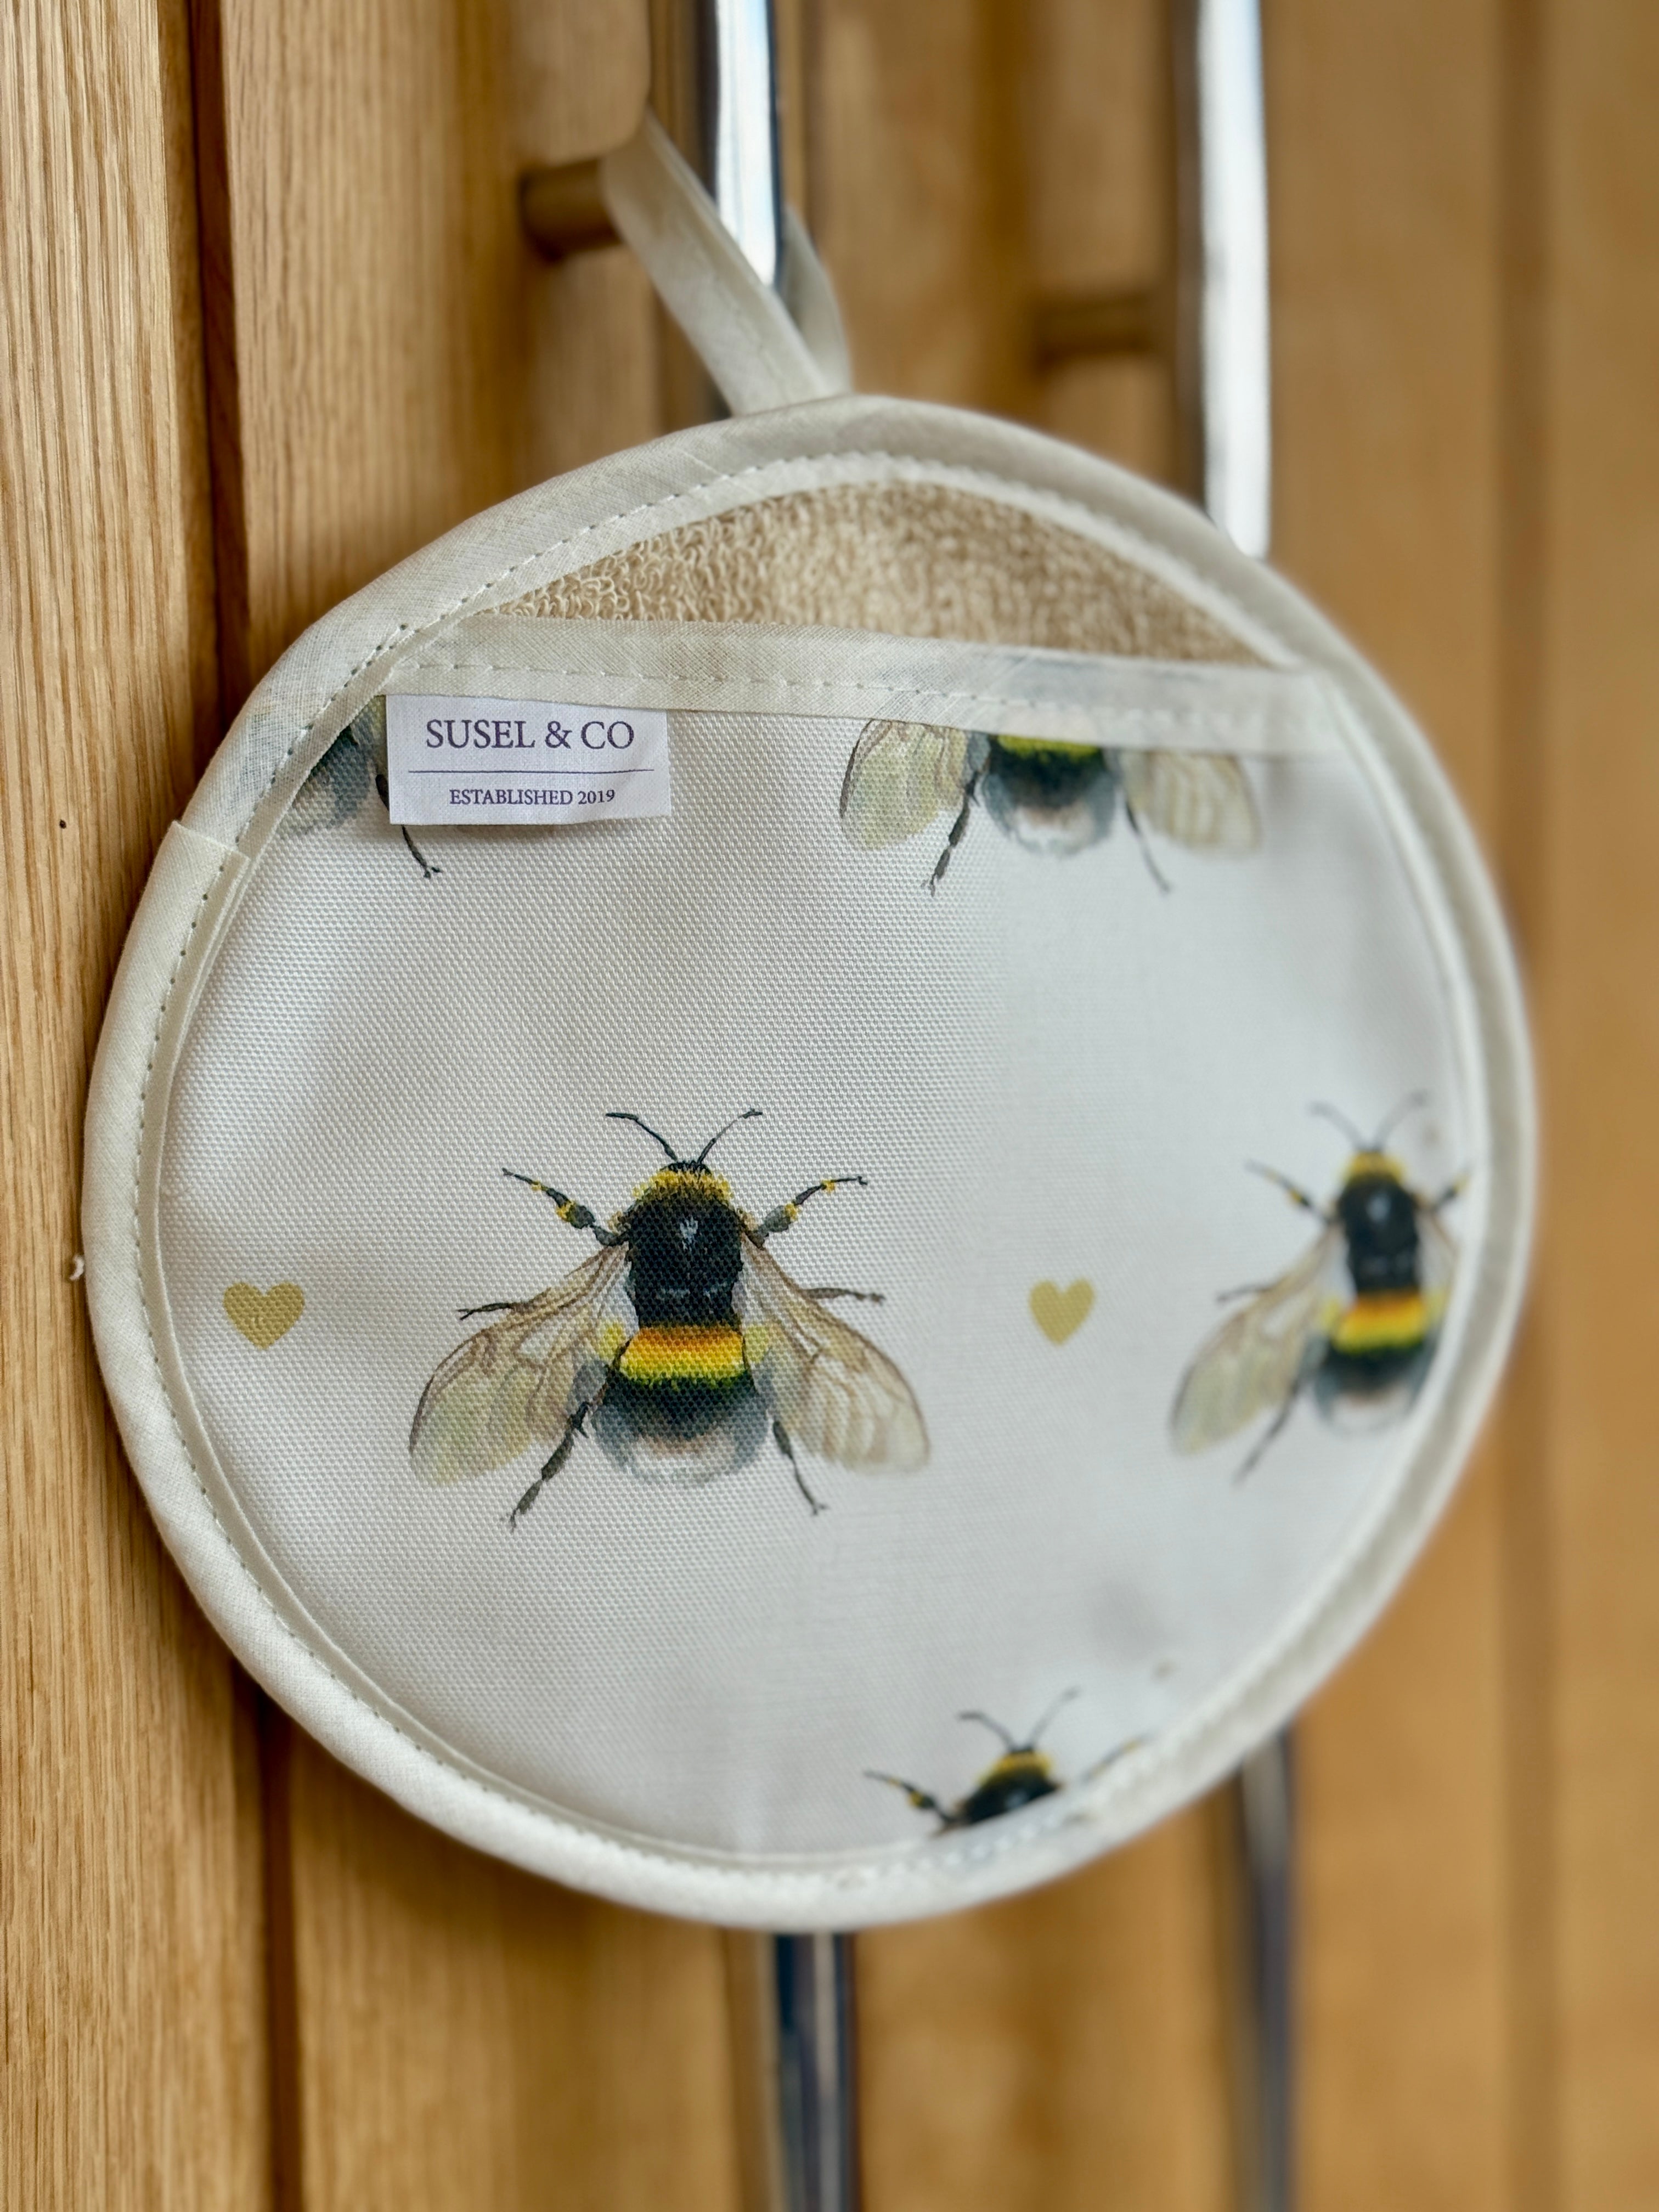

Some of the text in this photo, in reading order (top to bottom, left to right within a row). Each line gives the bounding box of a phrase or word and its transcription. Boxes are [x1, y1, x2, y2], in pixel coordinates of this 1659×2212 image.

[426, 719, 635, 750] SUSEL & CO
[449, 788, 616, 805] ESTABLISHED 2019
